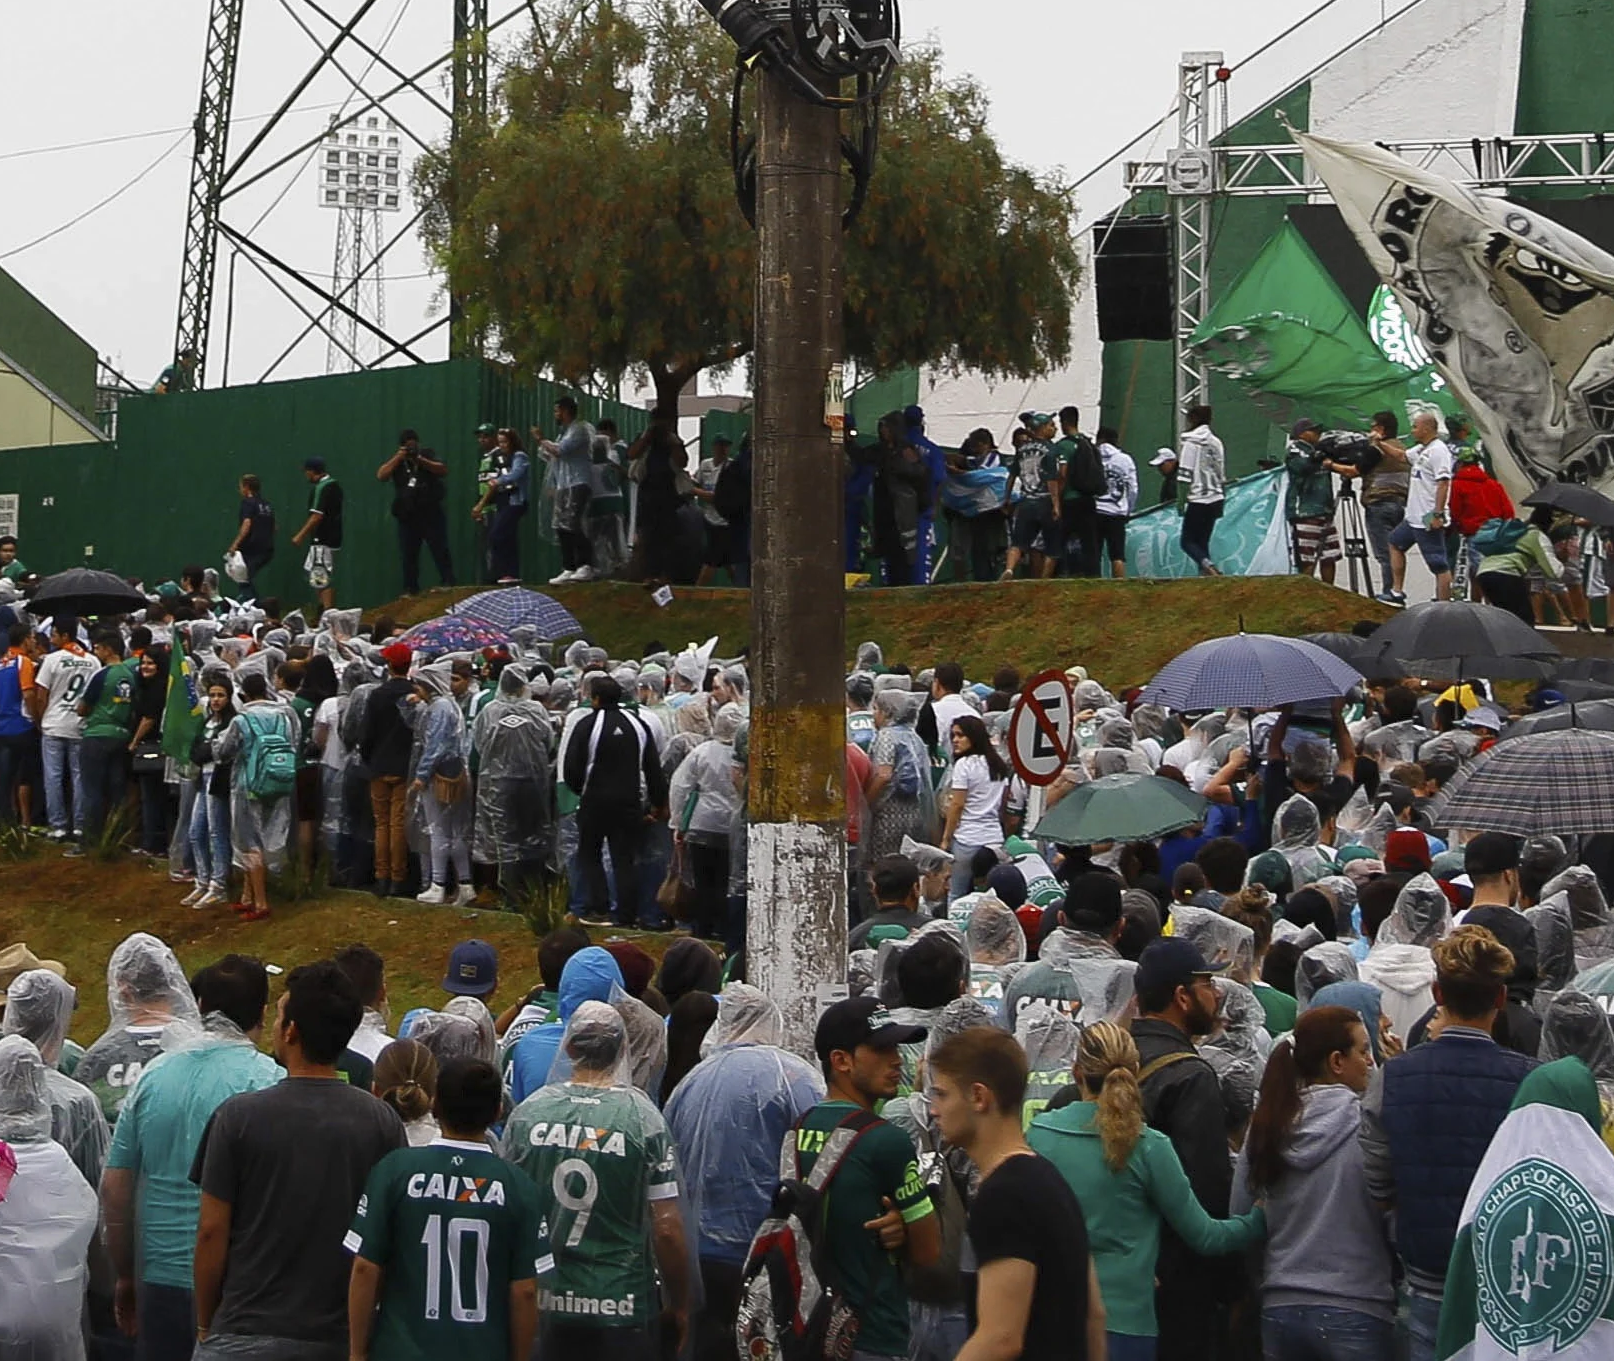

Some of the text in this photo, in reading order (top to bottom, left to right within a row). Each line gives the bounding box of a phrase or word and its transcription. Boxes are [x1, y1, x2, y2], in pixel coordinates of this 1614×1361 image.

[1033, 696, 1062, 759] E
[529, 1123, 626, 1156] CAIXA
[407, 1173, 505, 1206] CAIXA
[552, 1158, 599, 1247] 9
[1580, 1219, 1602, 1247] DE
[421, 1214, 490, 1322] 10
[1561, 1251, 1605, 1331] FUTEBOL
[537, 1289, 635, 1316] Unimed
